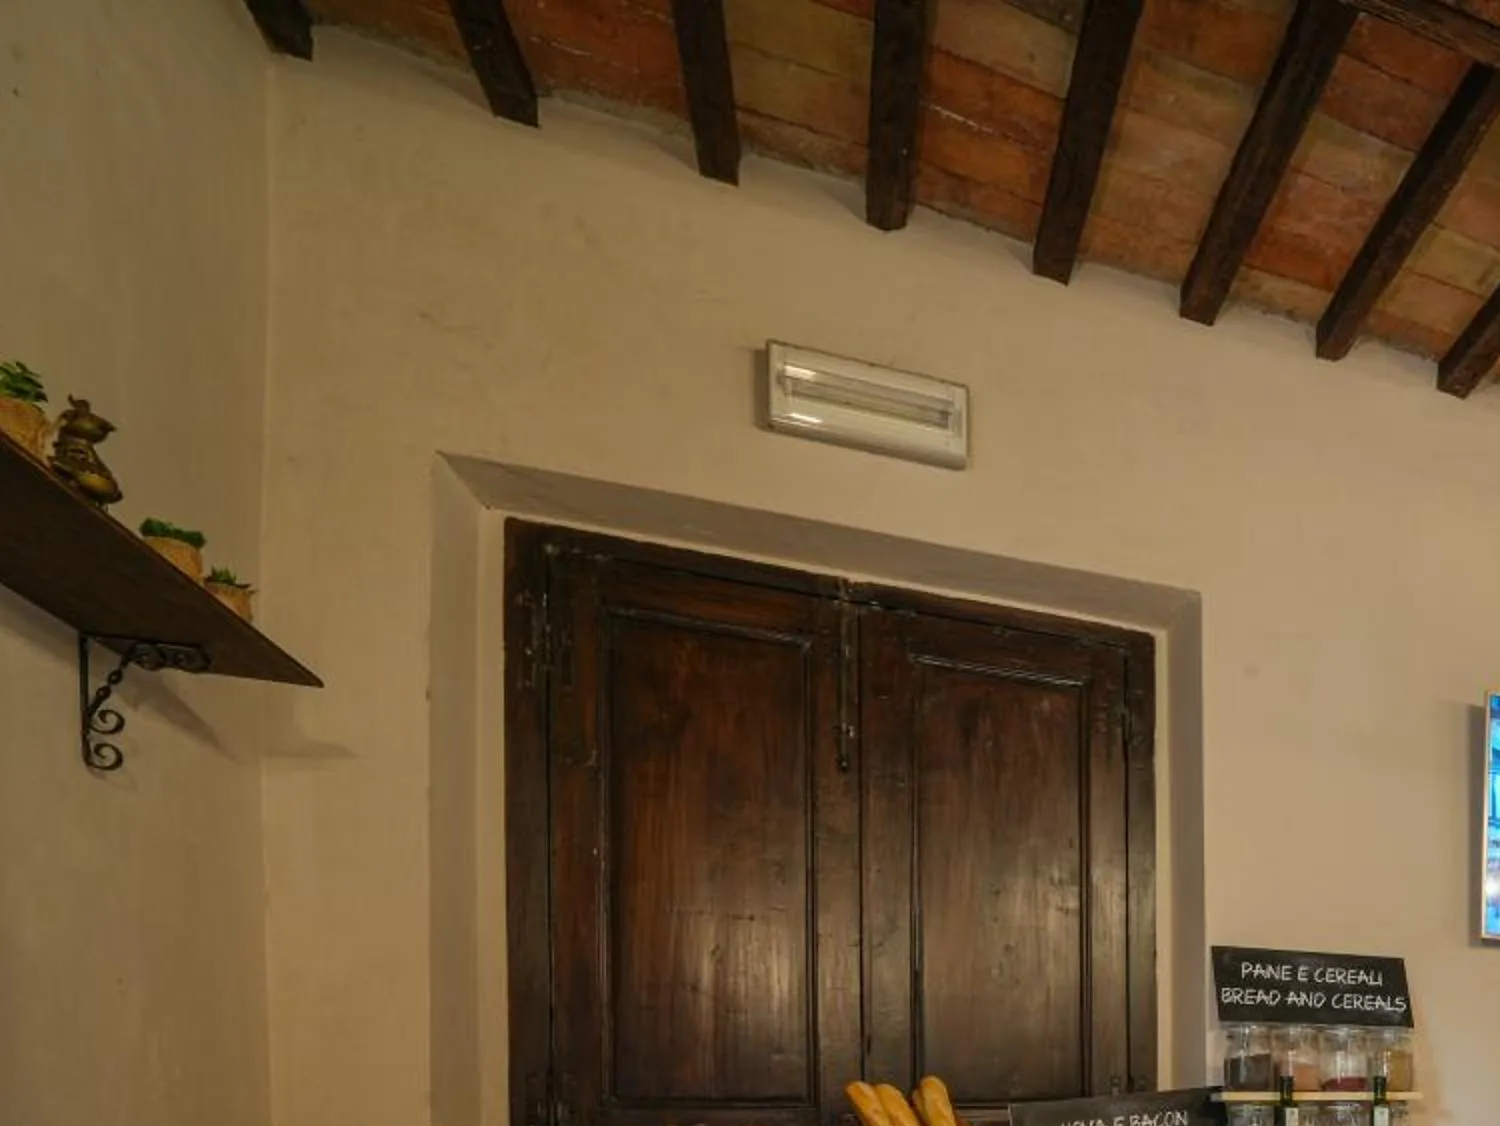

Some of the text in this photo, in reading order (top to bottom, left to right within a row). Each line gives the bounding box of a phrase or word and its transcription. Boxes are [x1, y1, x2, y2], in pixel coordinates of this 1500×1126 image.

[1241, 962, 1383, 986] PANE E CEREALI
[1221, 988, 1407, 1012] BREAD AND CEREALS
